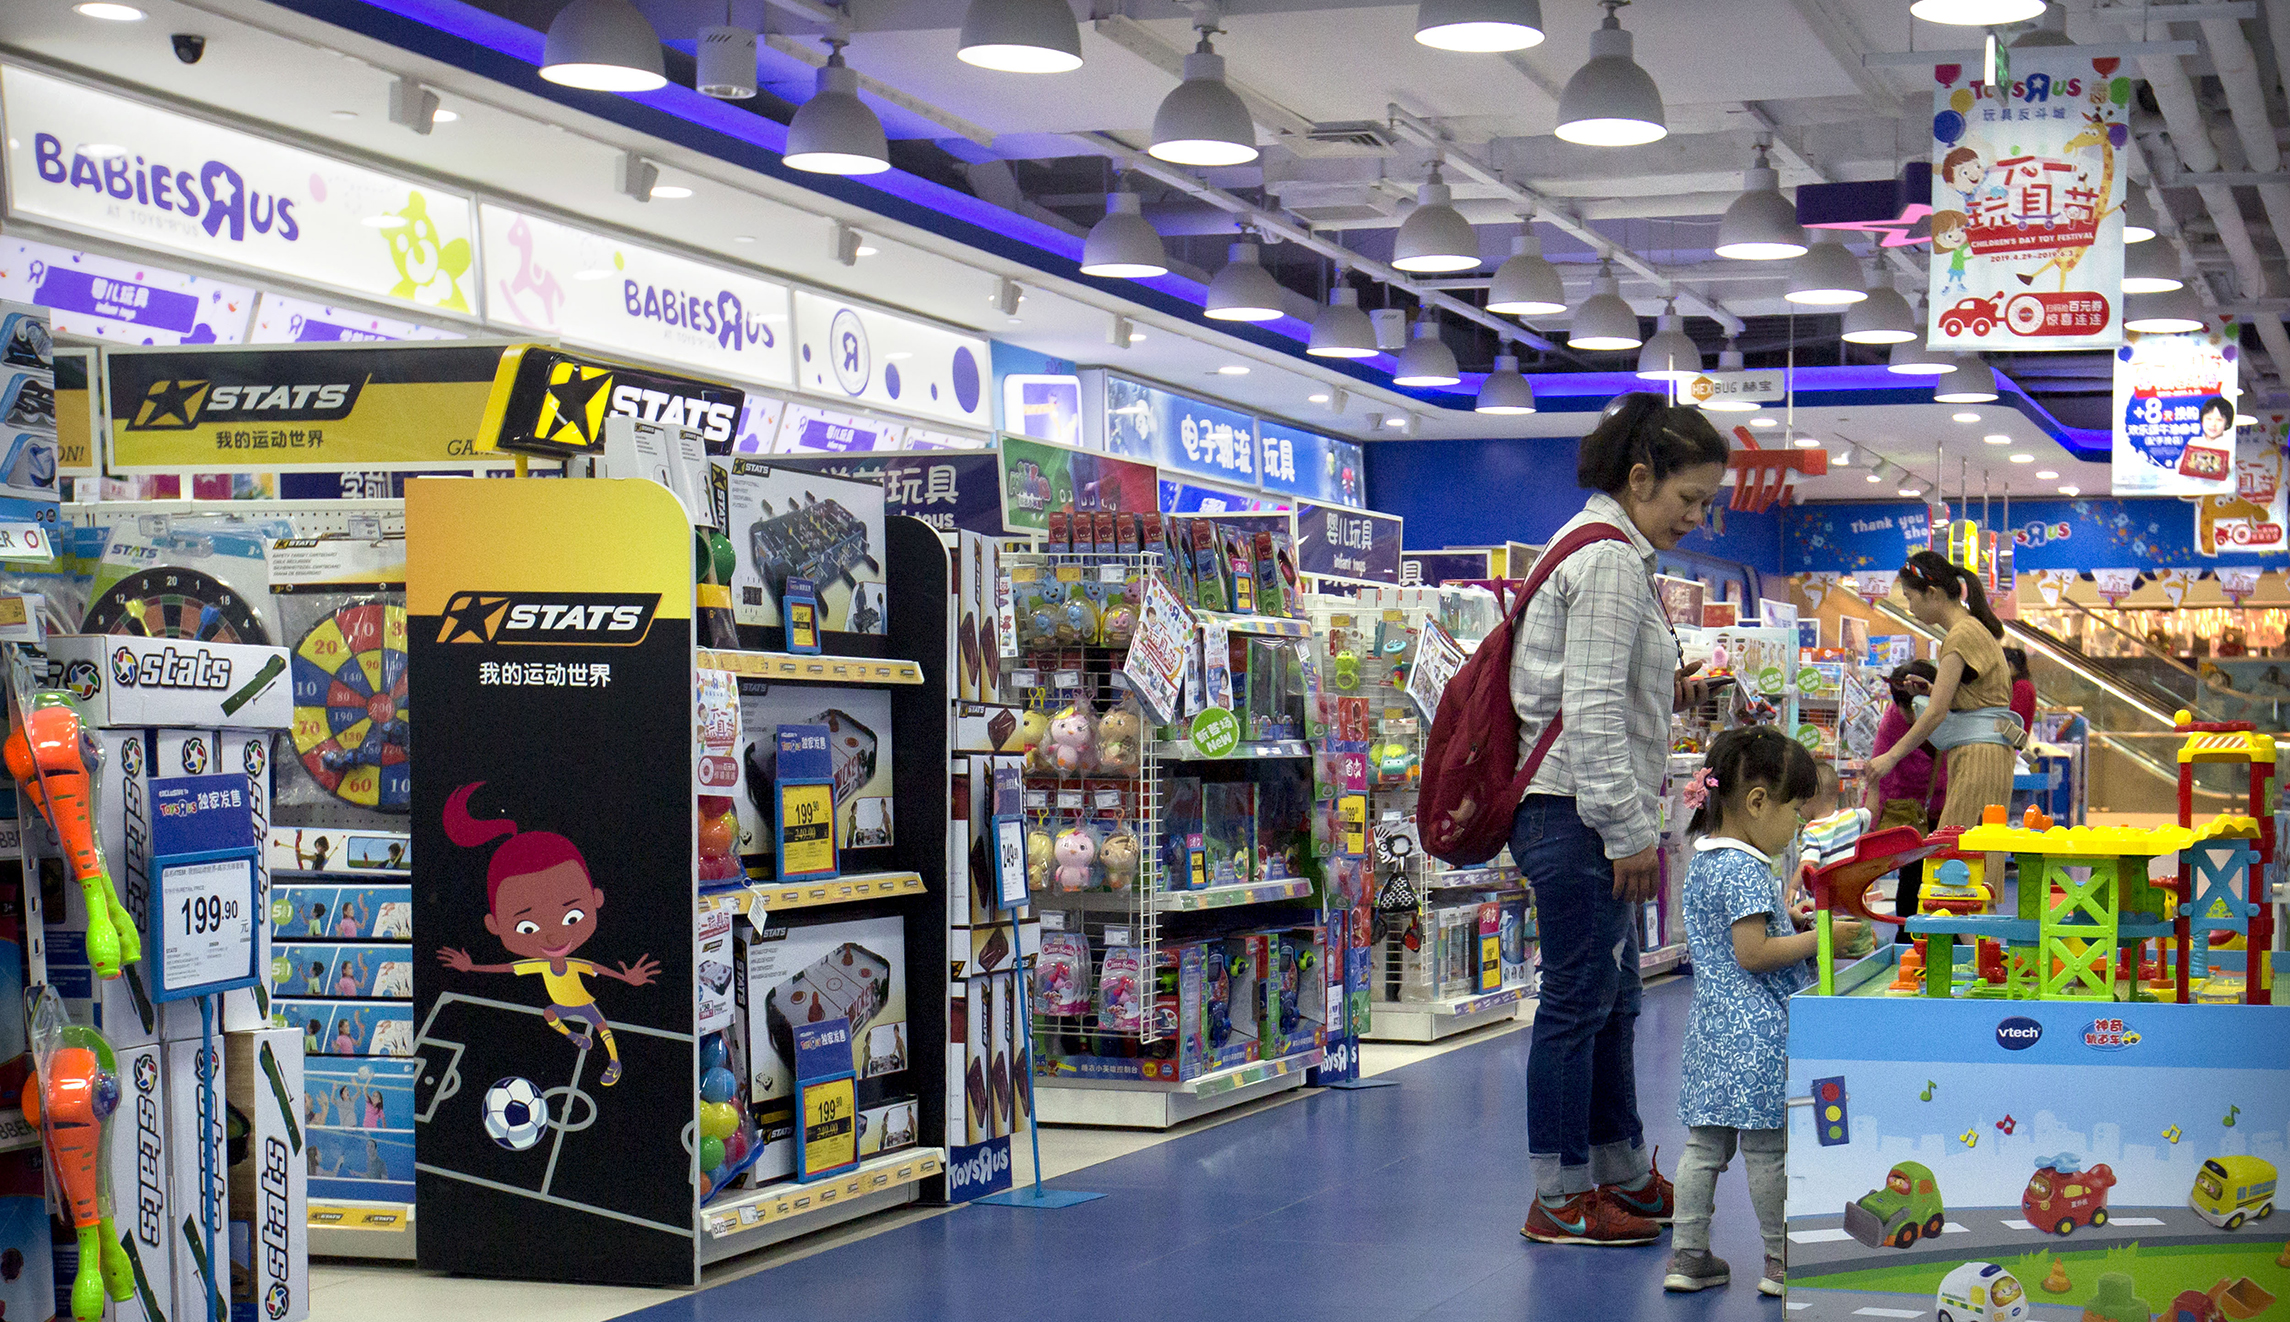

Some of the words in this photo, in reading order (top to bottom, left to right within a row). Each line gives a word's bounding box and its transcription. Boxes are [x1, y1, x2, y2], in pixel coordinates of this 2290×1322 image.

[1971, 237, 2017, 249] CHILDREN'S
[2019, 235, 2036, 245] DAY
[2039, 234, 2056, 243] TOY
[2057, 231, 2095, 243] FESTIVAL
[207, 384, 350, 410] STATS
[610, 385, 736, 442] STATS
[216, 430, 324, 449] 我的运动世界
[746, 462, 770, 474] STATS
[1326, 511, 1373, 551] 婴儿玩具
[1850, 516, 1894, 534] Thank
[1898, 513, 1925, 530] you
[111, 543, 159, 559] STATS
[288, 539, 317, 548] STATS
[166, 575, 178, 587] 20
[195, 579, 200, 591] 1
[115, 593, 126, 604] 12
[219, 595, 231, 605] 18
[242, 618, 250, 629] 4
[506, 604, 643, 630] STATS
[353, 621, 375, 638] 10
[314, 639, 338, 655] 20
[139, 647, 233, 690] stats
[366, 660, 380, 671] 90
[479, 661, 612, 688] 我的运动世界
[296, 681, 317, 697] 10
[336, 691, 350, 702] 80
[371, 702, 392, 714] 200
[334, 711, 353, 722] 190
[299, 720, 320, 736] 70
[350, 777, 372, 794] 60
[391, 777, 411, 794] 10
[197, 788, 242, 811] 独家发售
[181, 894, 239, 936] 199.90
[240, 918, 250, 935] 元
[764, 927, 787, 939] STATS
[1997, 1026, 2040, 1039] vtech
[2094, 1018, 2123, 1032] 神奇
[137, 1094, 163, 1248] stats
[261, 1136, 288, 1282] stats
